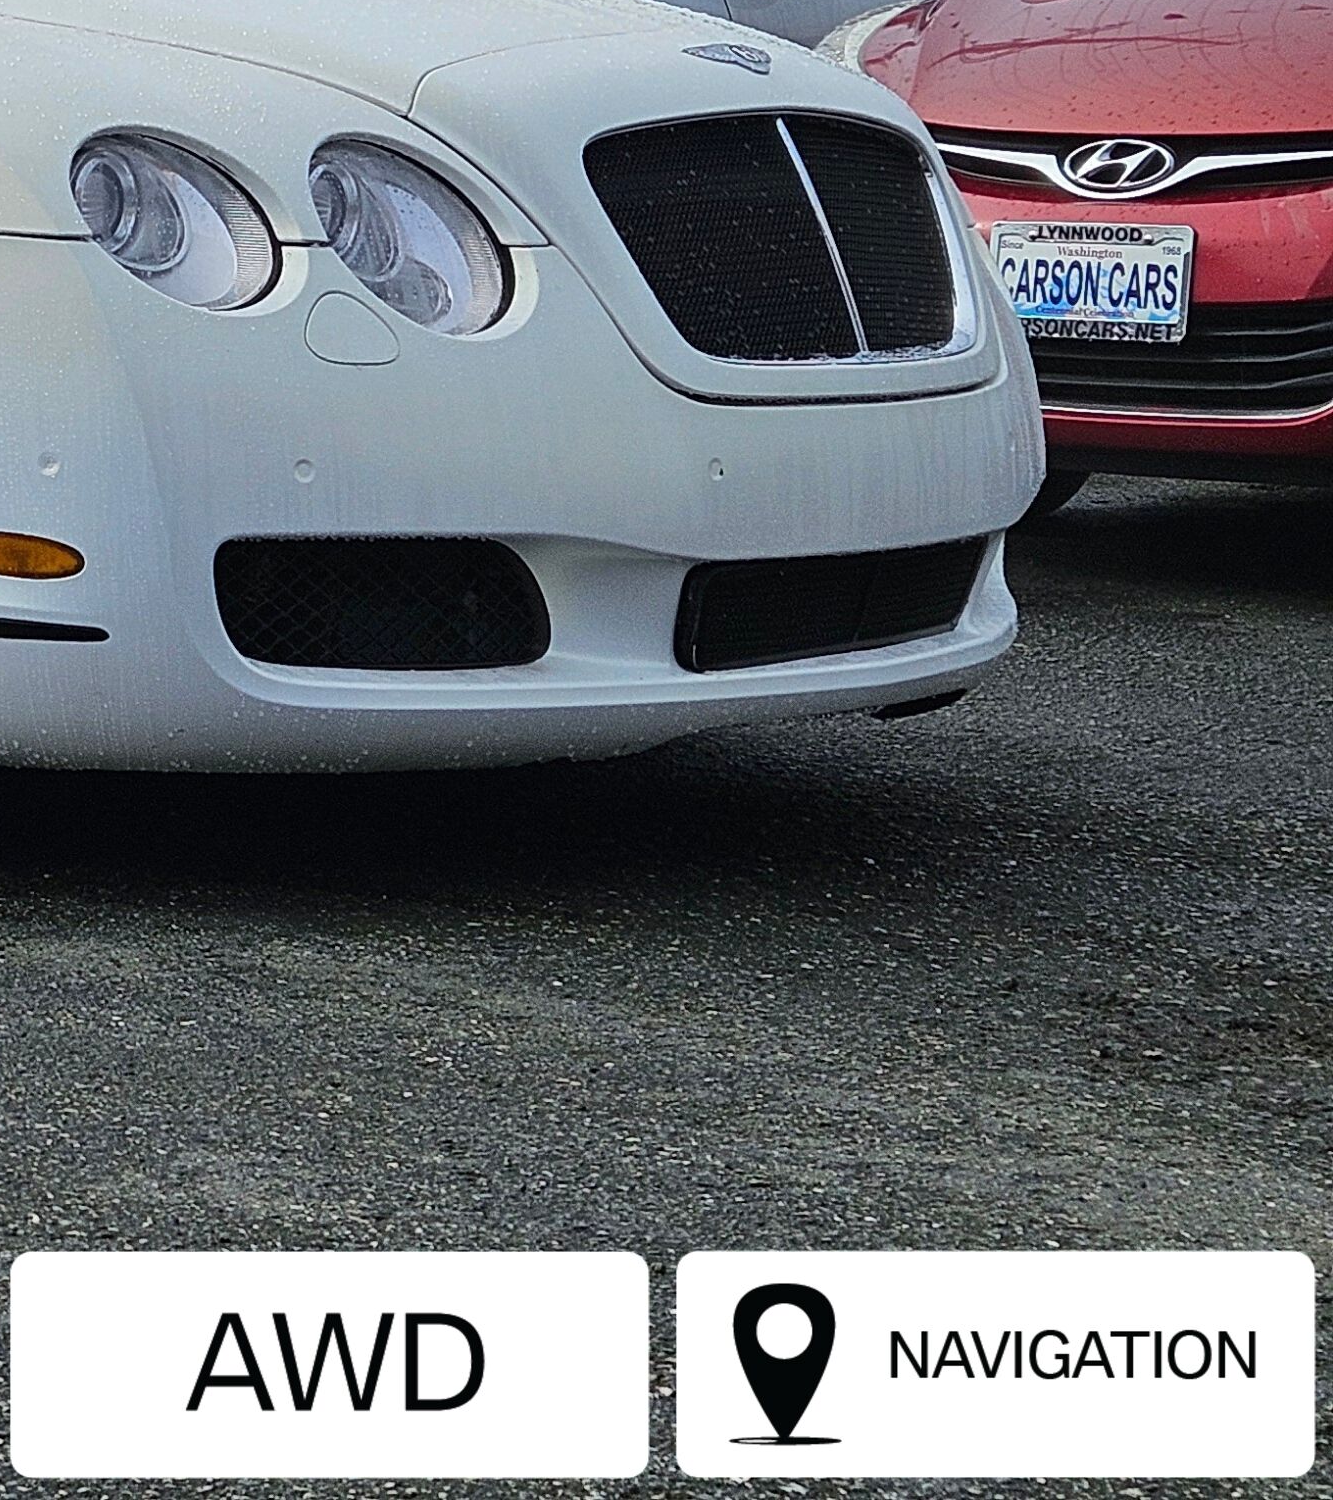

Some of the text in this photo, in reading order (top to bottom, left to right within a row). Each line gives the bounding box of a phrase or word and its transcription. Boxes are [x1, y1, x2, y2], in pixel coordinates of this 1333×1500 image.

[1037, 225, 1144, 242] LYNNWOOD
[1001, 240, 1024, 250] Since
[1057, 246, 1122, 259] Washington
[1001, 258, 1179, 311] CARSON CARS
[1021, 319, 1176, 341] RSONCARS.NET
